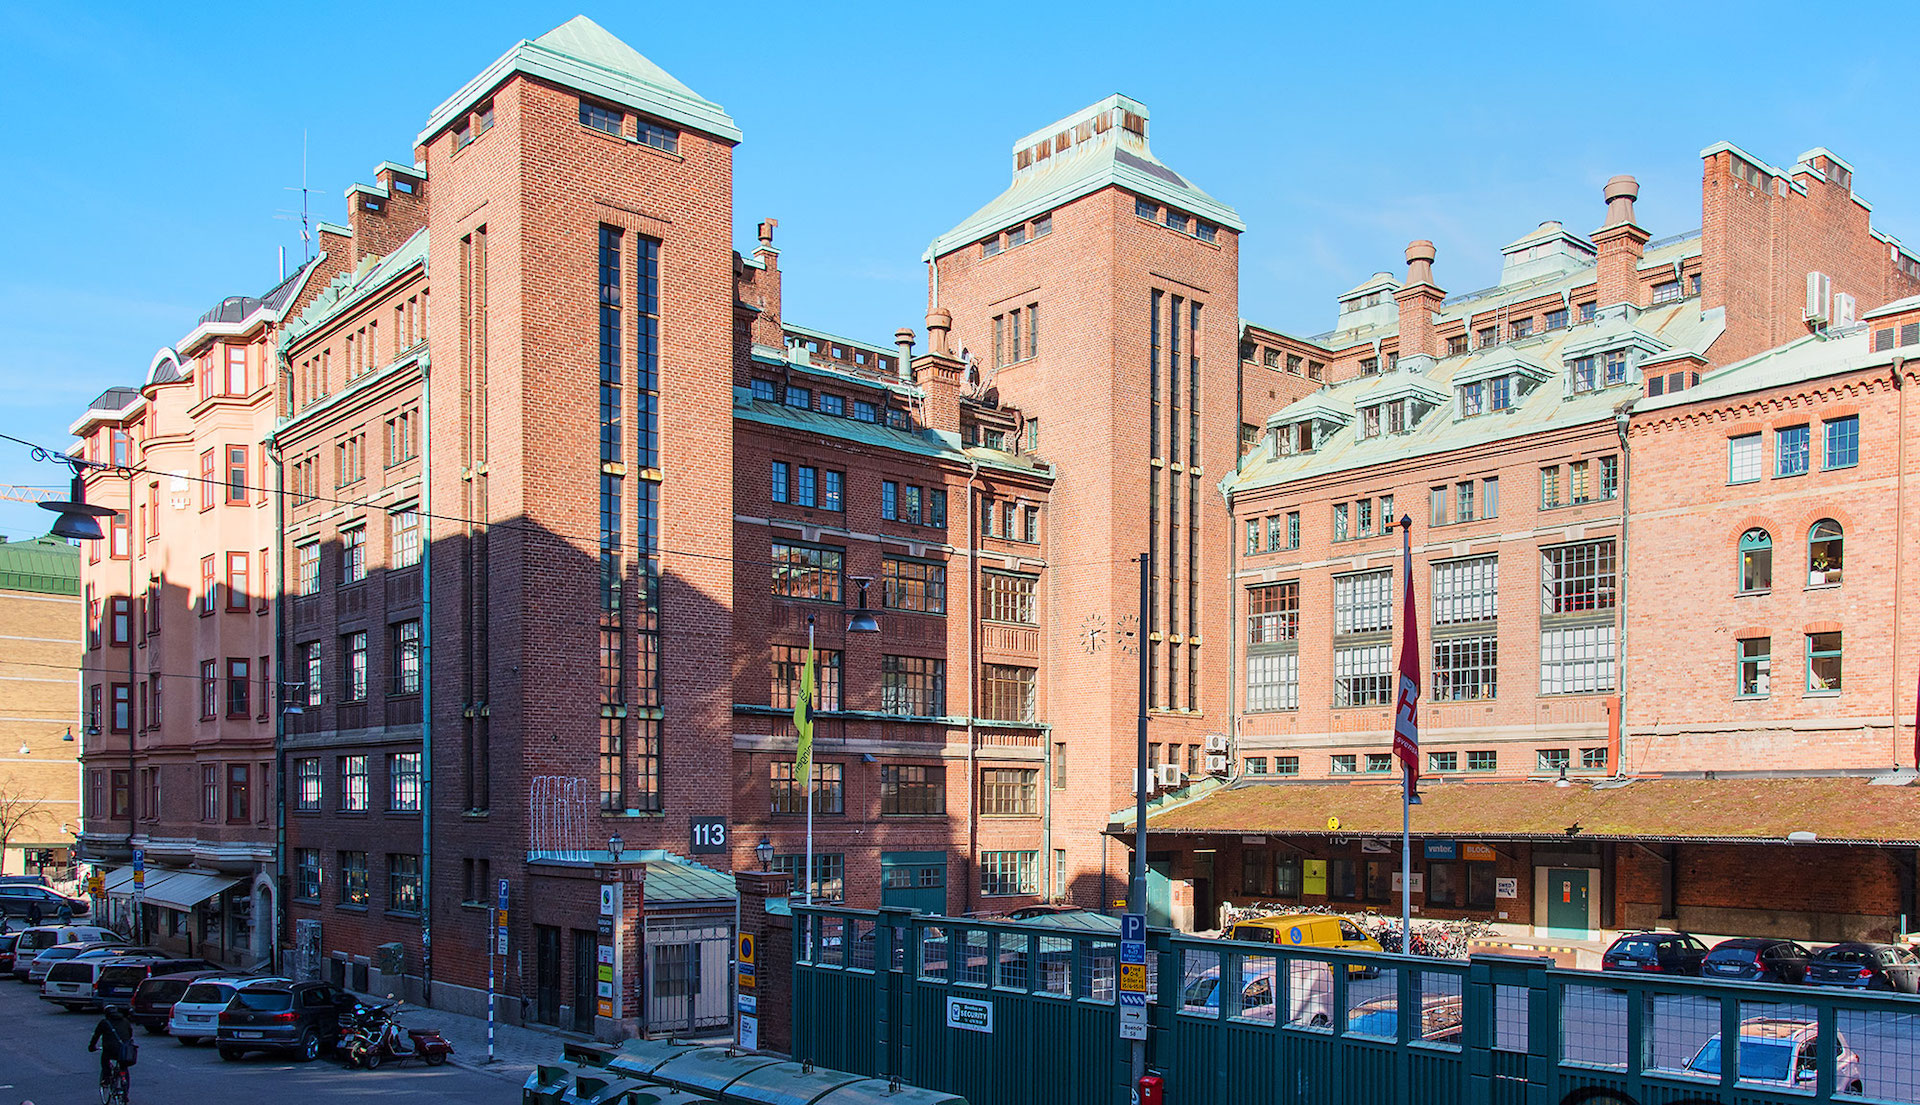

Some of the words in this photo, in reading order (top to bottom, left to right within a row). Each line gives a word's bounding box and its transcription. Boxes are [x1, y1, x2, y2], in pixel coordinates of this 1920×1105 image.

[693, 823, 725, 845] 113
[1466, 846, 1490, 854] BLOCK
[501, 881, 507, 895] P
[1128, 917, 1140, 938] P
[960, 1010, 987, 1020] SECURITY
